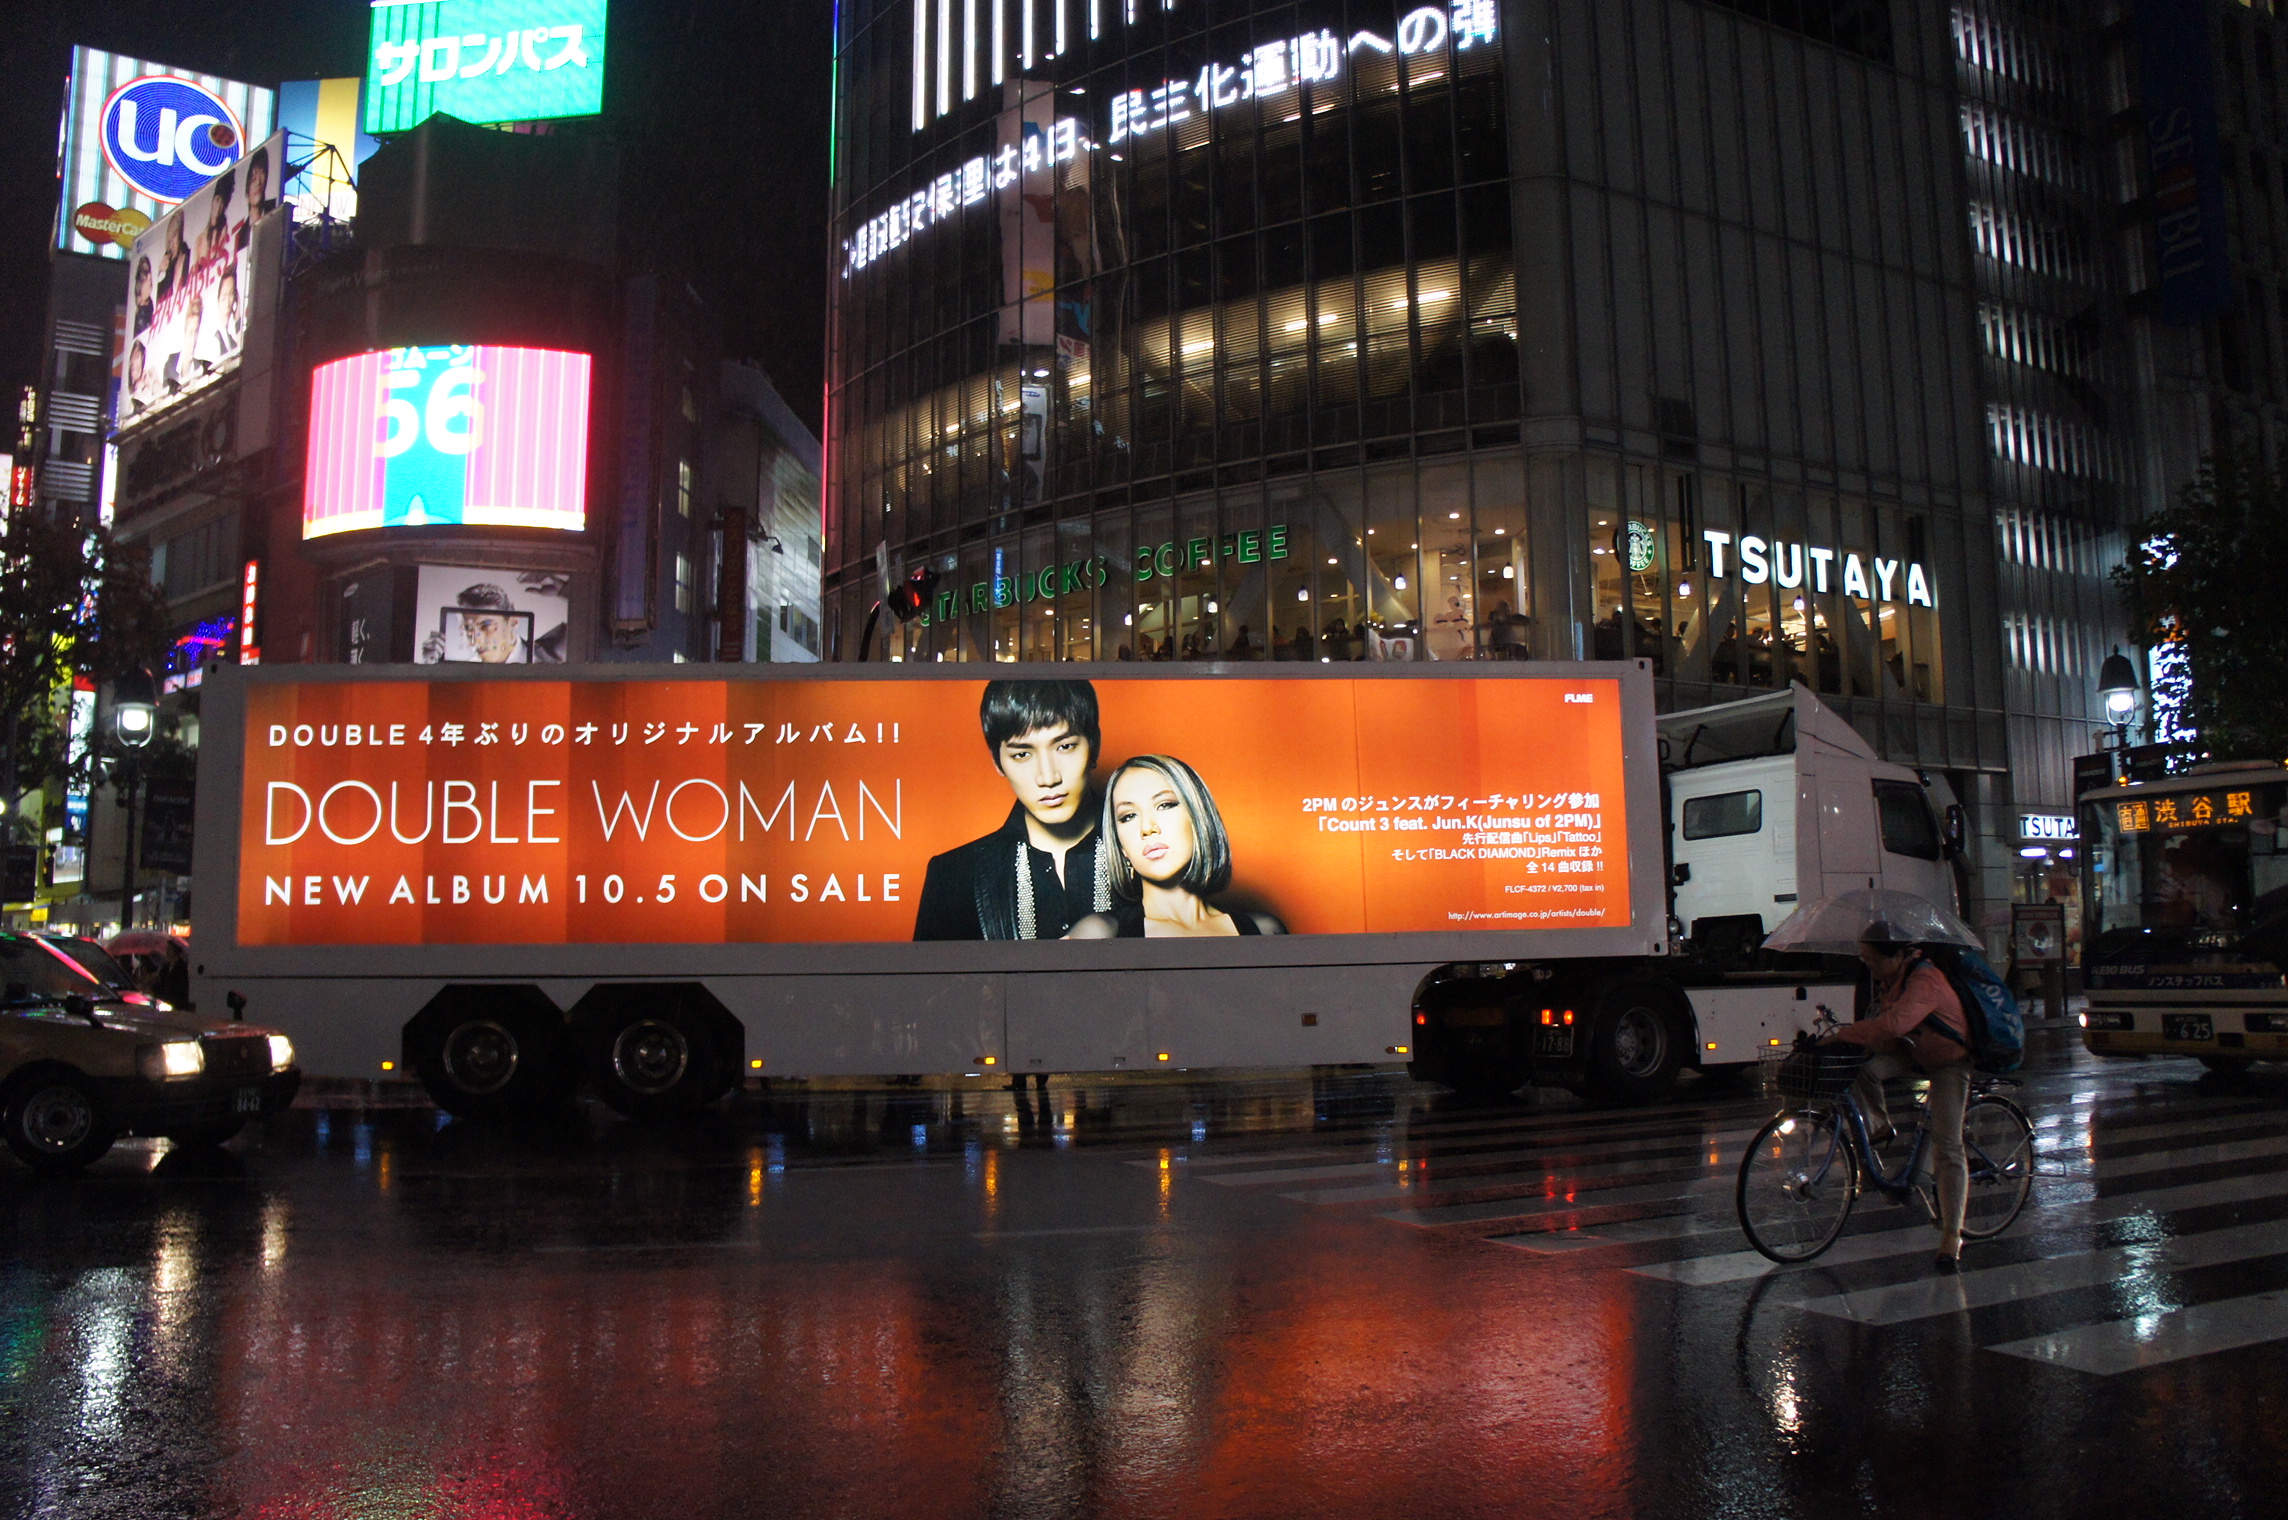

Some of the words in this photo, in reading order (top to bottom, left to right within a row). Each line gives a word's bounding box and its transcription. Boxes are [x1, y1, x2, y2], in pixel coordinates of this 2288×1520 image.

[375, 25, 588, 87] サロンパス
[373, 366, 486, 459] 56
[1138, 524, 1288, 582] COFFEE
[1703, 529, 1933, 608] TSUTAYA
[269, 724, 406, 746] DOUBLE
[265, 779, 562, 846] DOUBLE
[591, 777, 902, 843] WOMAN
[1379, 816, 1390, 831] 3
[1393, 816, 1428, 831] feat.
[1431, 814, 1531, 831] Jun.K(Junsu
[1534, 813, 1551, 828] of
[2154, 791, 2253, 823] 渋谷駅
[2167, 819, 2211, 829] SHIBUYA
[264, 873, 371, 906] NEW
[388, 873, 550, 906] ALBUM
[574, 873, 677, 904] 10.5
[698, 872, 768, 904] ON
[789, 872, 901, 903] SALE
[1504, 884, 1547, 893] FLCF-4372
[2089, 964, 2118, 975] KEIO
[2118, 963, 2146, 975] BUS
